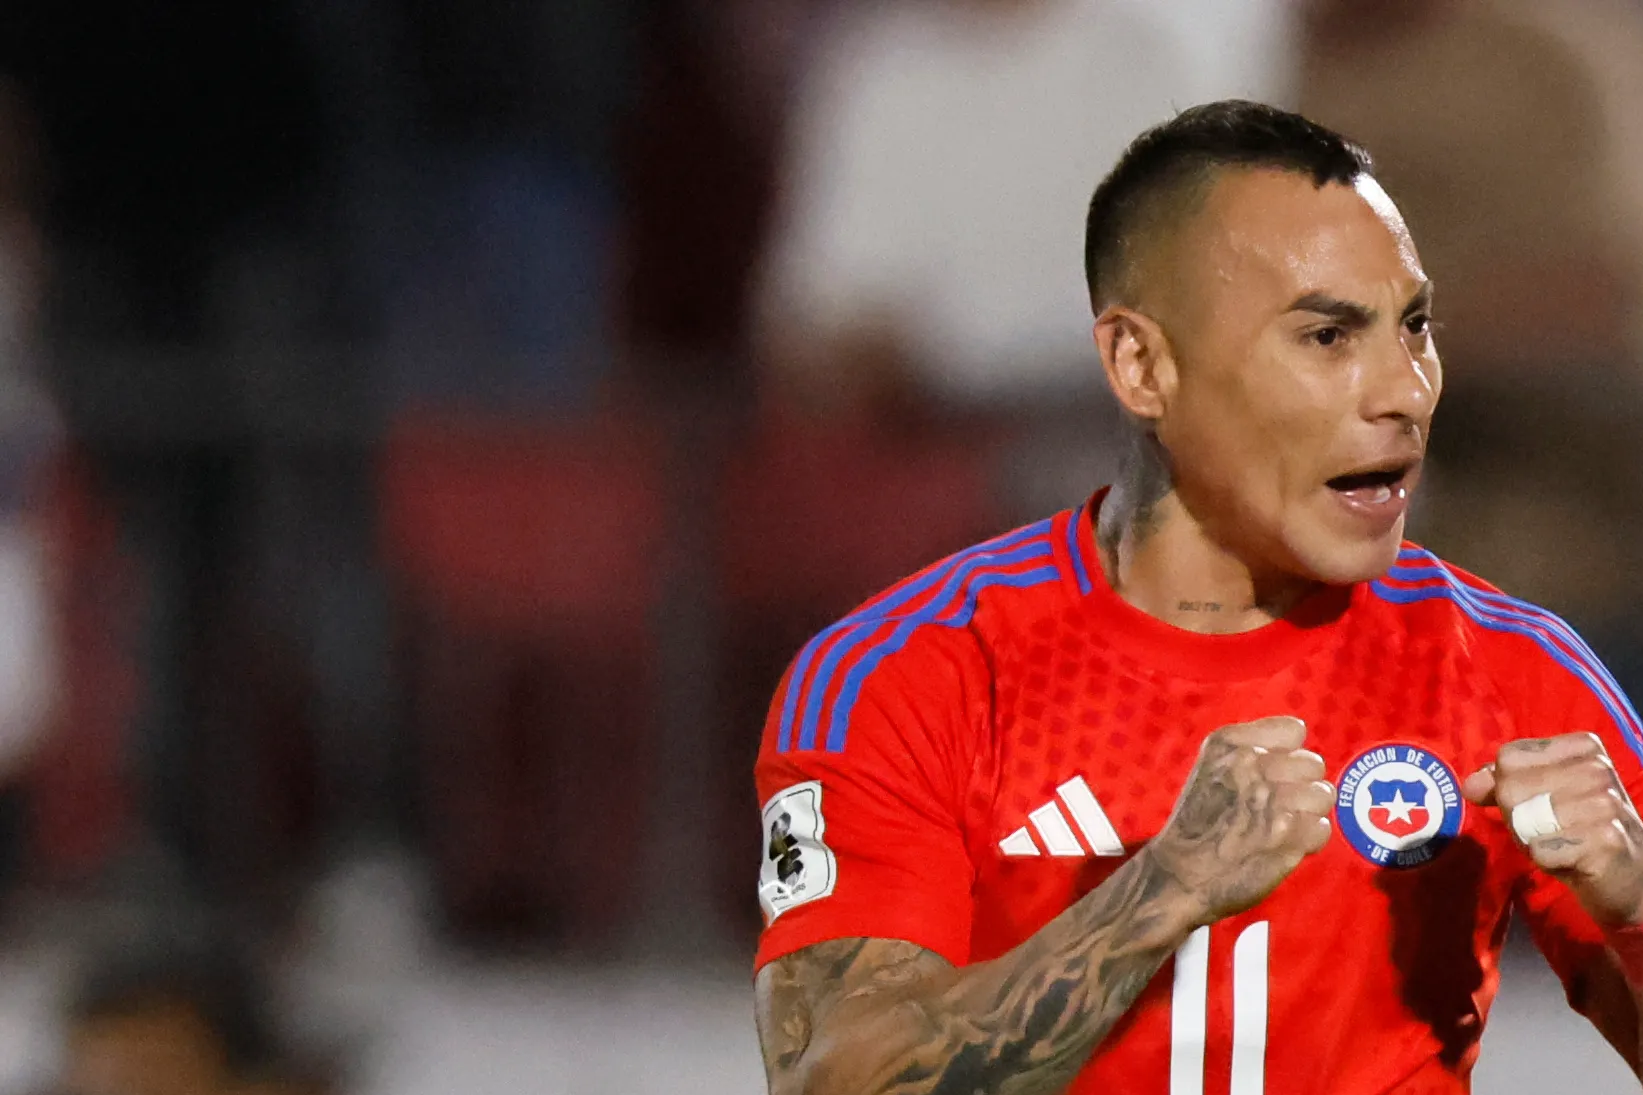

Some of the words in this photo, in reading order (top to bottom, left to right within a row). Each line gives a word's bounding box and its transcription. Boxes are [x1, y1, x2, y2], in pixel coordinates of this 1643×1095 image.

[1339, 747, 1396, 808] FEDERACION
[1407, 748, 1425, 765] DE
[1426, 761, 1458, 808] FUTBOL
[1371, 847, 1390, 863] DE
